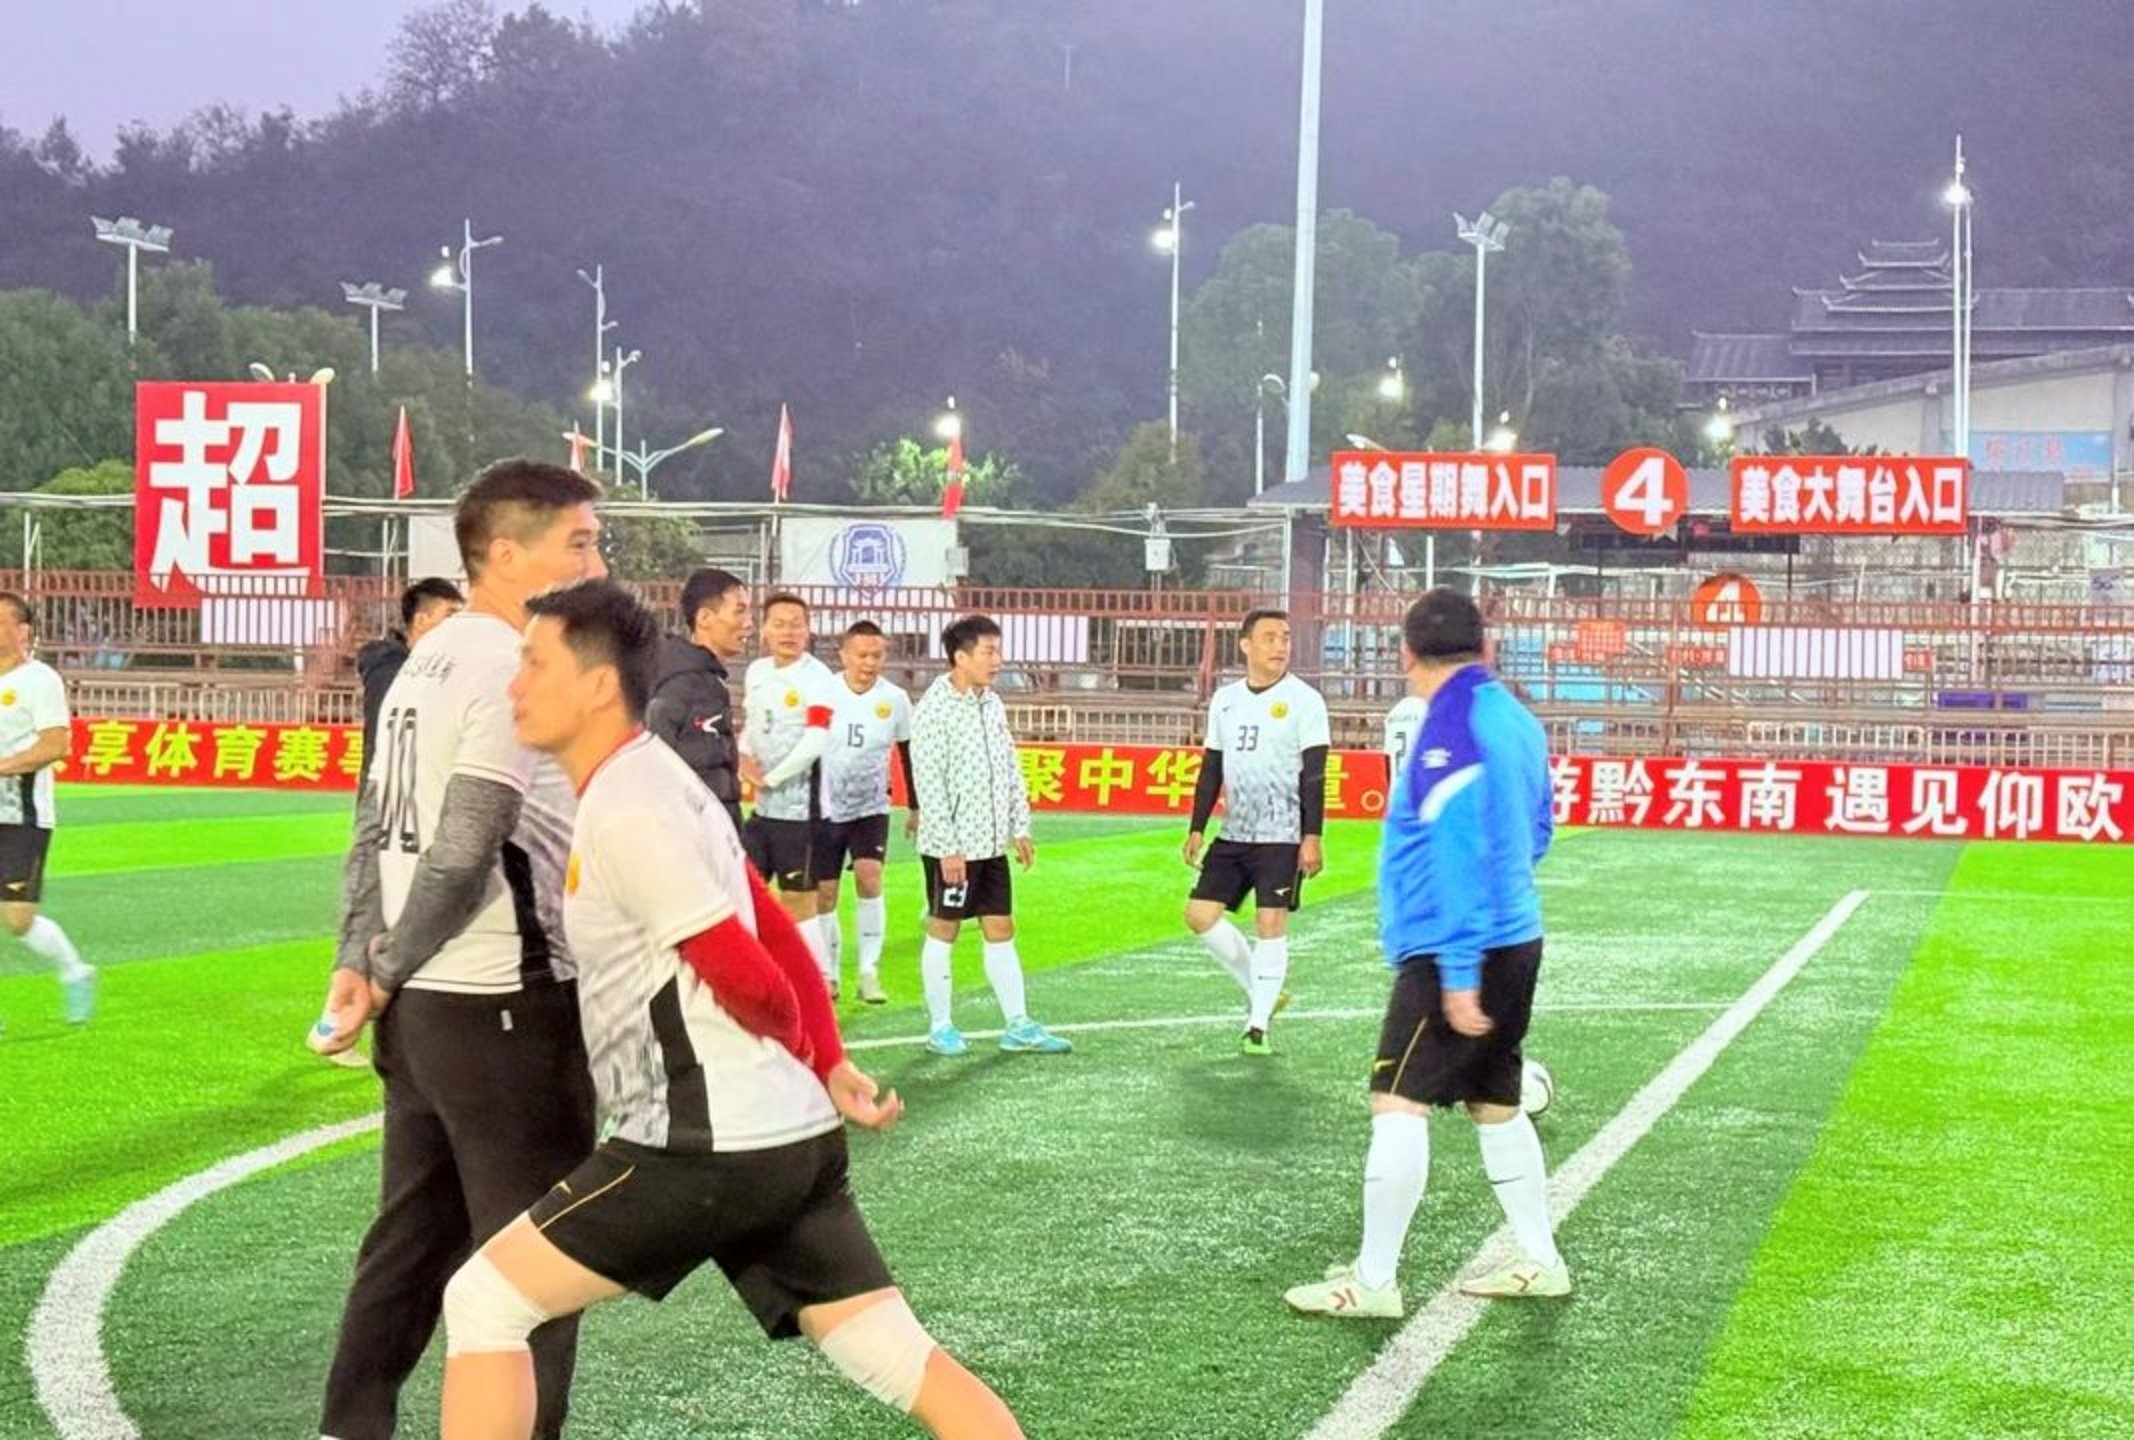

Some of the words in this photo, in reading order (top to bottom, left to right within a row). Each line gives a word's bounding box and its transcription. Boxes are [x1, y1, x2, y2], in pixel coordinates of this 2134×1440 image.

[150, 390, 311, 596] 超
[1615, 457, 1675, 526] 4
[1740, 465, 1962, 525] 美食大舞台入口
[1705, 581, 1746, 622] 4
[52, 719, 363, 782] 享体育赛
[847, 723, 865, 748] 15
[1236, 725, 1260, 752] 33
[1824, 767, 2124, 841] 遇见仰欧
